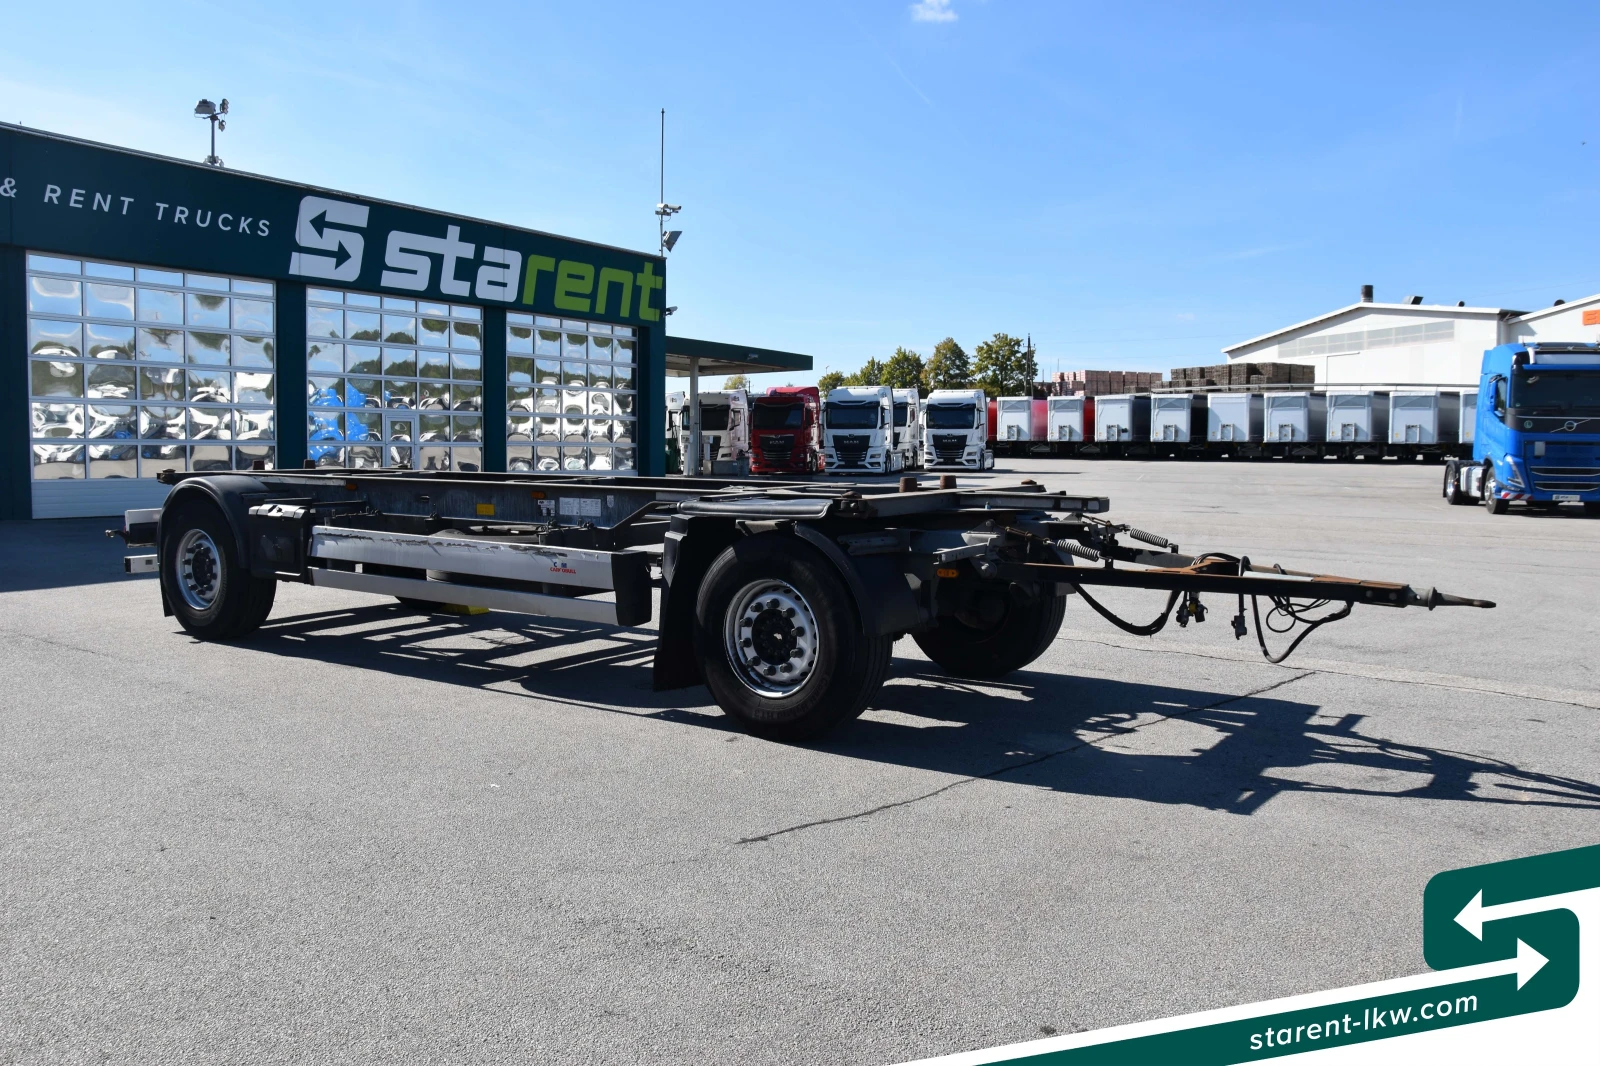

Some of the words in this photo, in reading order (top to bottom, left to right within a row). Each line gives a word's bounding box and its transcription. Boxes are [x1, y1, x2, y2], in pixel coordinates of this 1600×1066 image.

[0, 177, 18, 198] &
[44, 184, 134, 215] RENT
[155, 202, 271, 237] TRUCKS
[380, 224, 664, 322] starent
